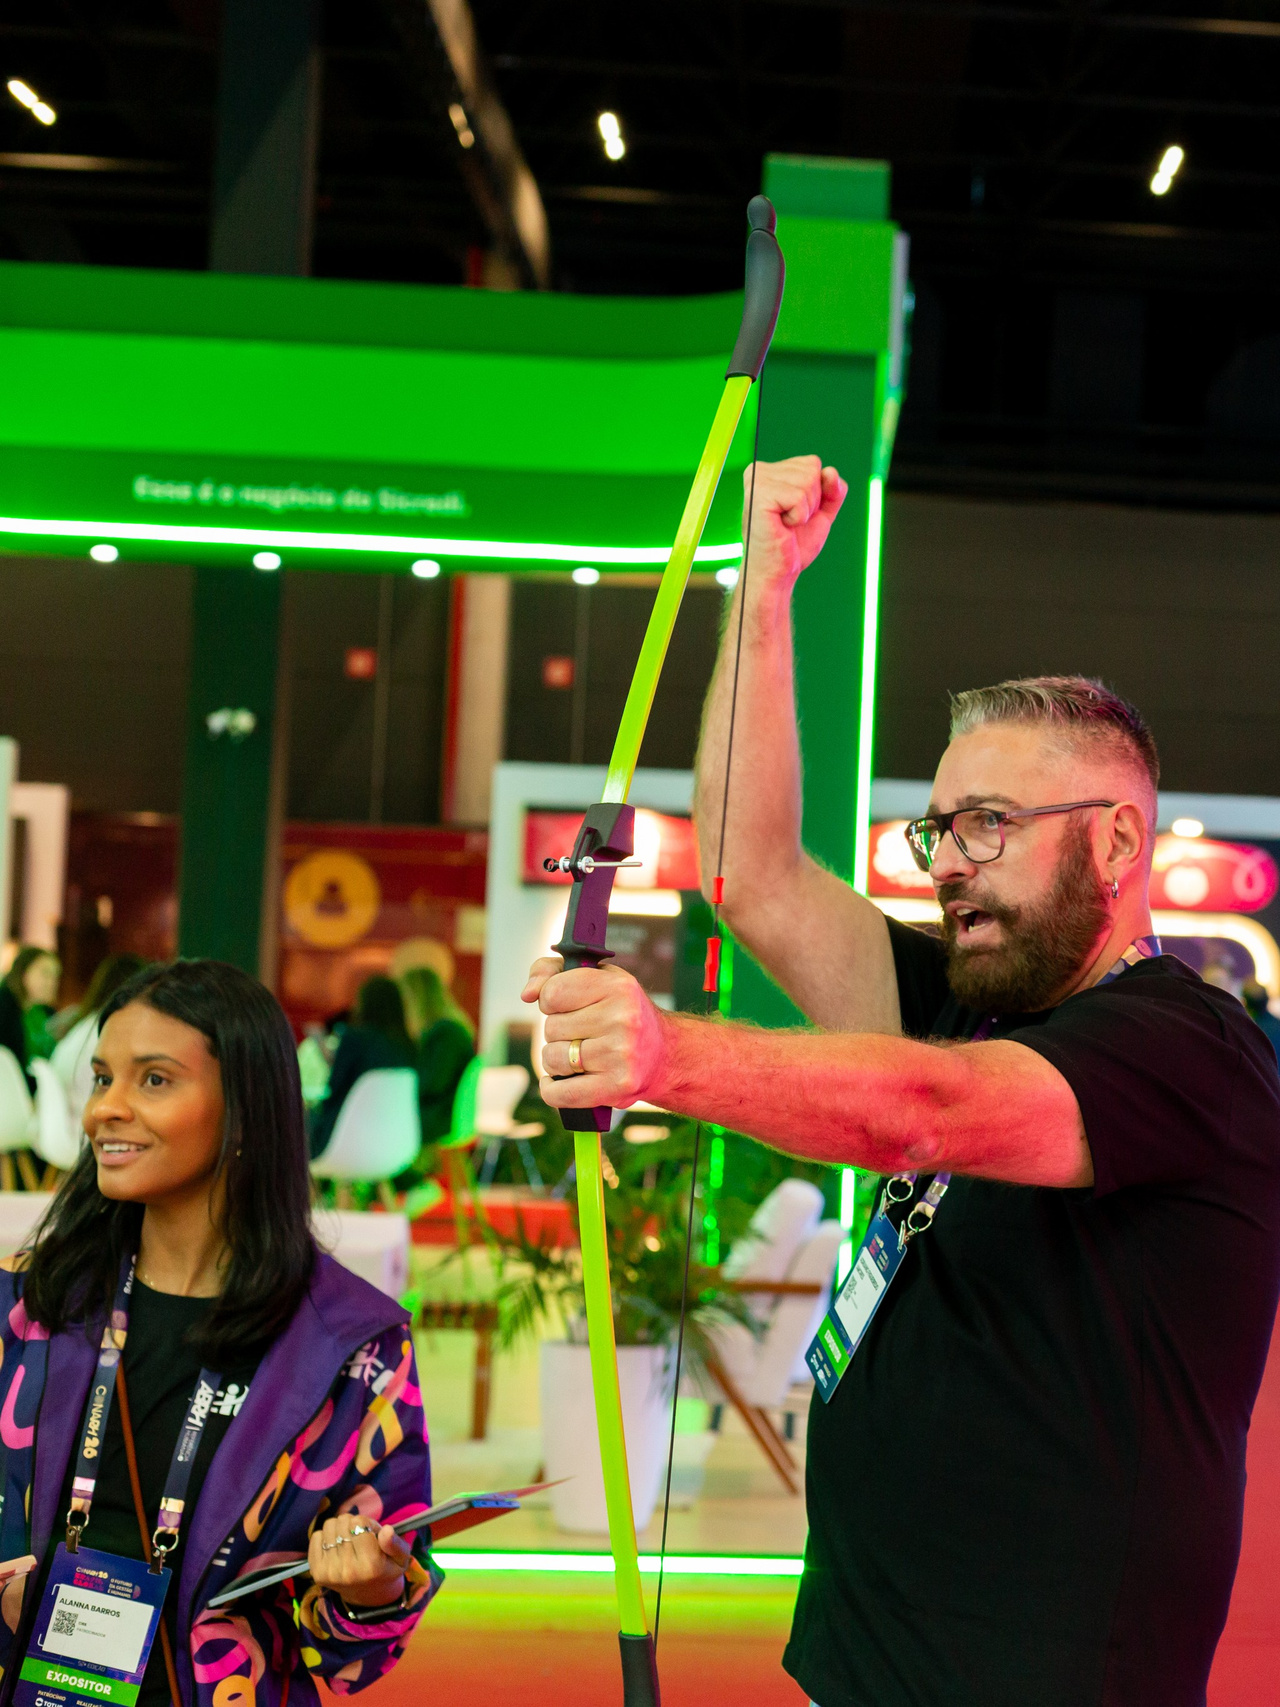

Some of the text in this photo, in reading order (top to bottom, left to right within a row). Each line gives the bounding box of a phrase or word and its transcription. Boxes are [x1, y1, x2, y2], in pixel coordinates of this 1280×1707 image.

[58, 1597, 121, 1618] ALANNA BARROS
[46, 1670, 112, 1695] EXPOSITOR
